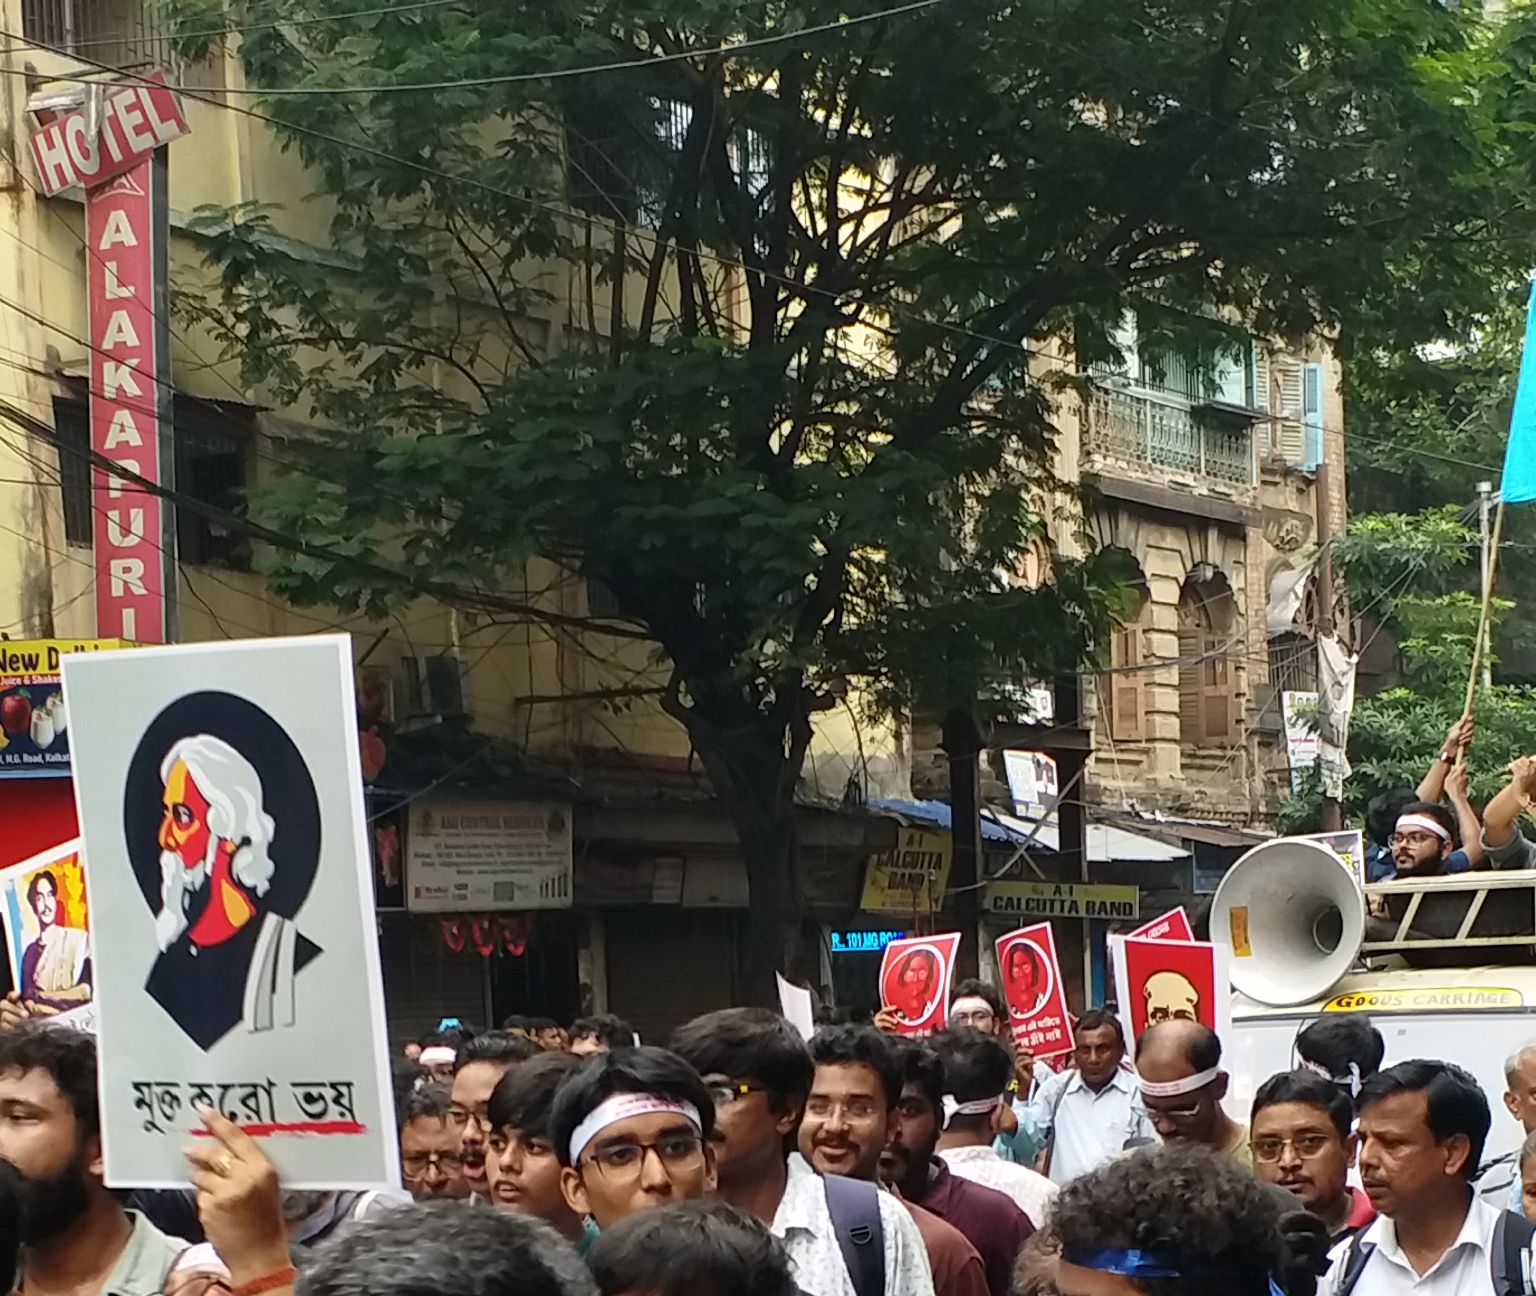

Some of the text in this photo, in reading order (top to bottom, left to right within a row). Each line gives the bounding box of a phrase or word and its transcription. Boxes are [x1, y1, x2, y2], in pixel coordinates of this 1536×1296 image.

[34, 84, 181, 194] HOTEL
[0, 676, 22, 686] Juice
[24, 675, 31, 685] &
[45, 753, 71, 763] Kolkat
[993, 895, 1133, 916] CALCUTTA BAND
[846, 932, 863, 947] 101
[864, 932, 879, 947] MG
[1336, 991, 1512, 1009] GOODS CARRIAGE
[131, 1081, 183, 1135] মুক্ত
[290, 1081, 359, 1127] ভয়
